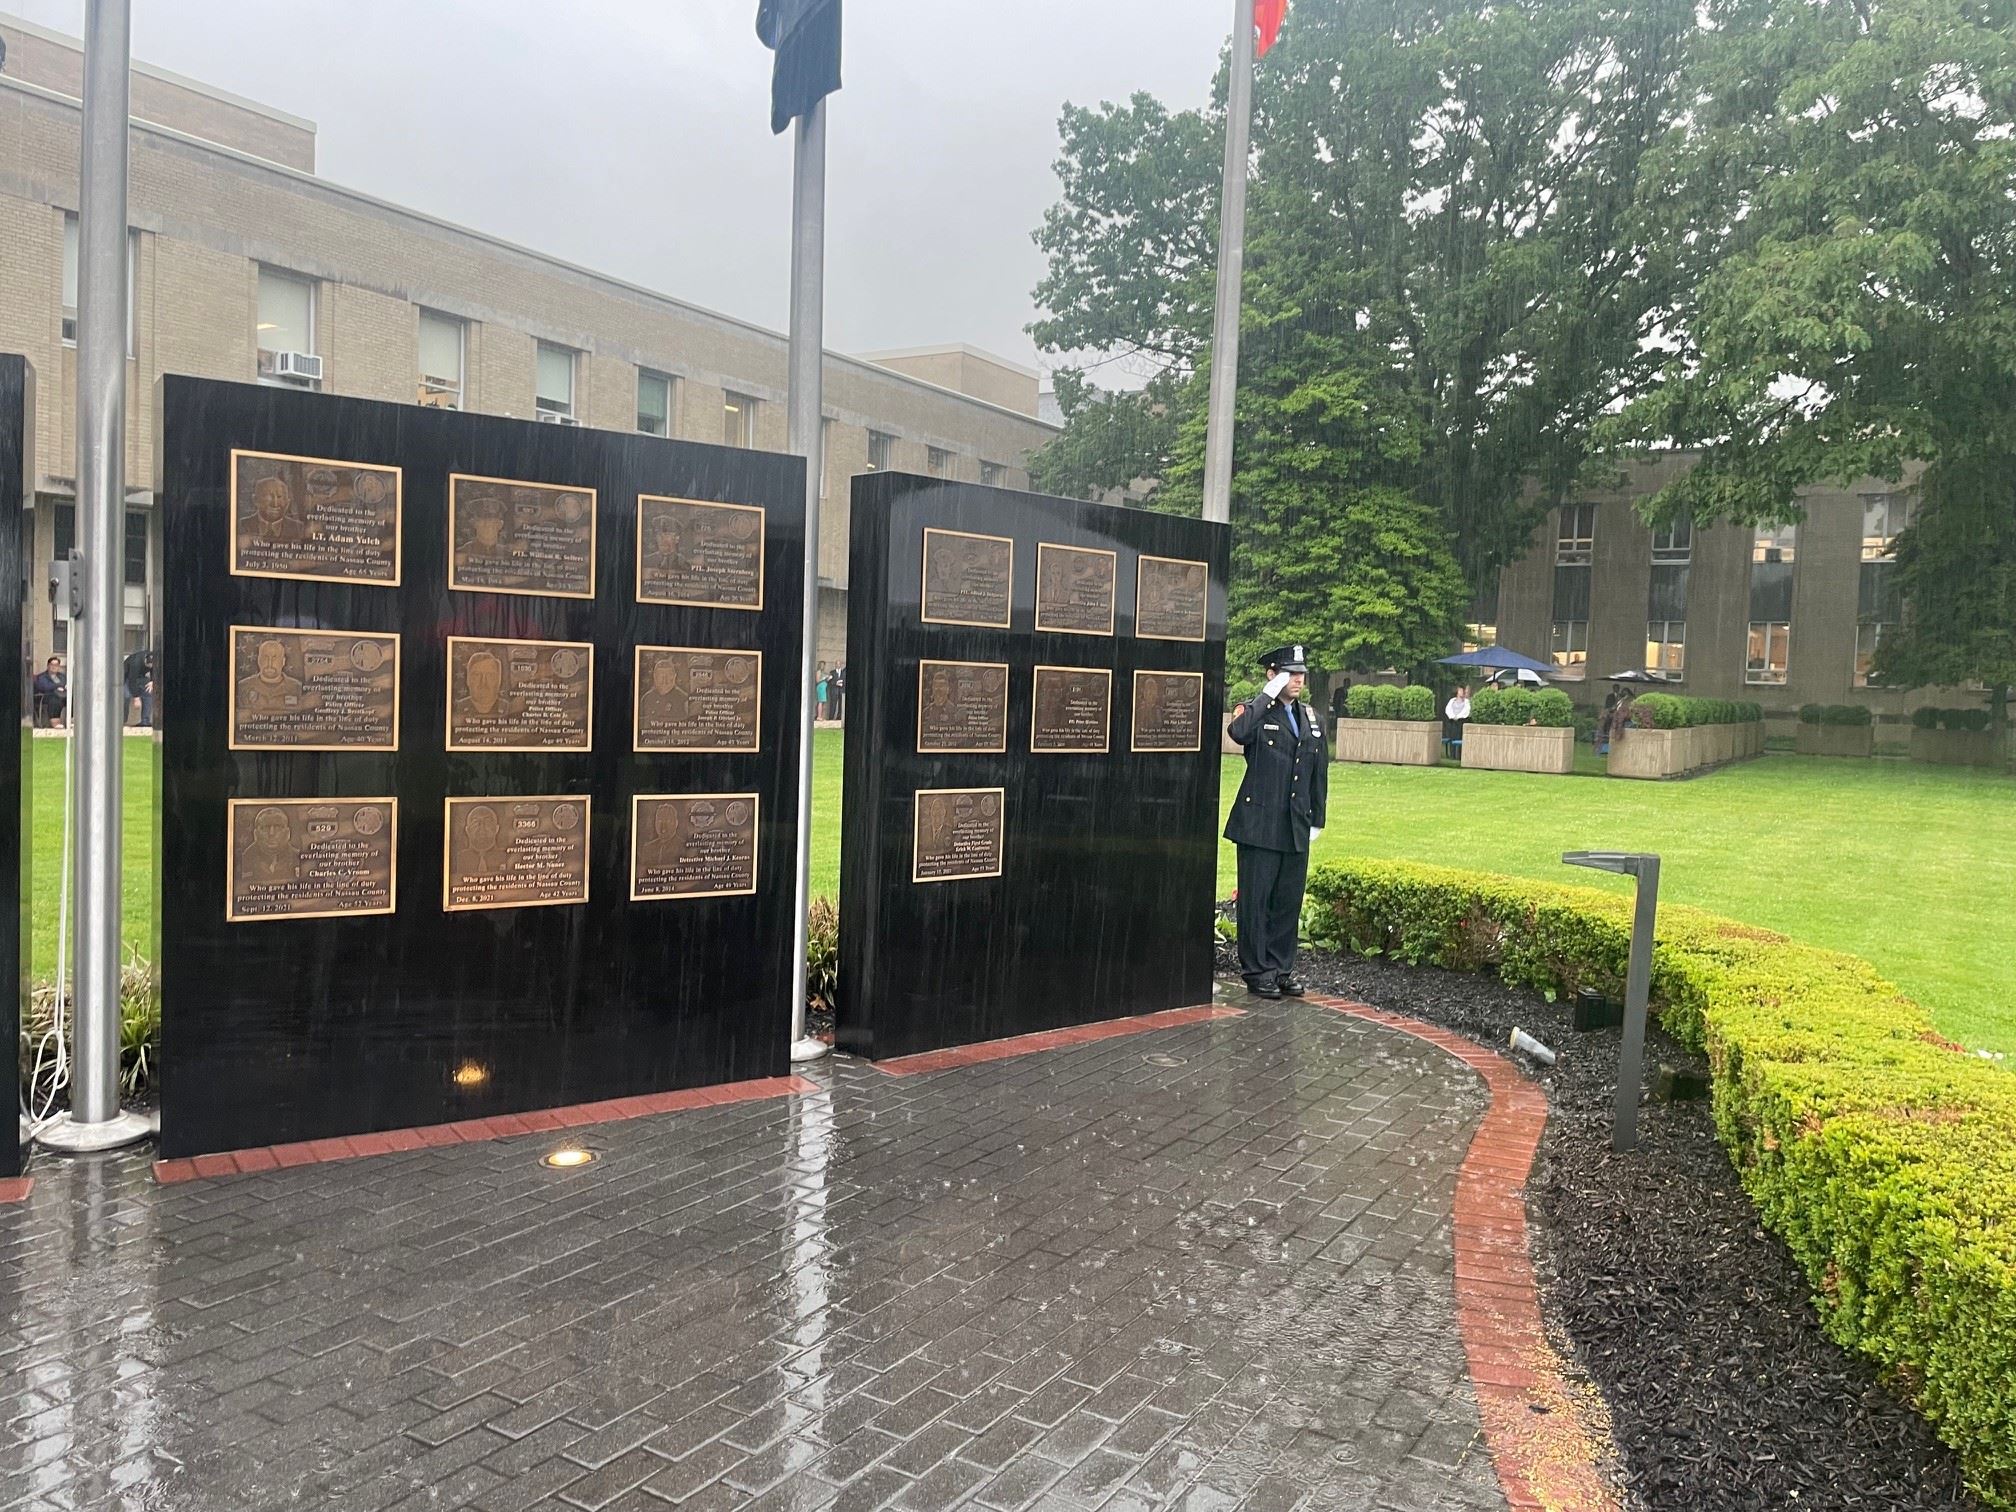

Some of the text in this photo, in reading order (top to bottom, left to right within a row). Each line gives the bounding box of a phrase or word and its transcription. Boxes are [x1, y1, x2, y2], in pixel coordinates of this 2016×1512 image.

[316, 505, 353, 514] Dedicated
[365, 508, 376, 516] the
[307, 514, 346, 524] everlasting
[348, 518, 376, 526] memory
[340, 525, 366, 533] brother
[329, 535, 353, 543] Adam
[356, 536, 380, 546] Yulch
[272, 542, 288, 550] gave
[240, 550, 279, 559] protecting
[295, 553, 327, 561] residents
[366, 557, 391, 567] County
[453, 884, 485, 893] protecting
[238, 893, 276, 902] protecting
